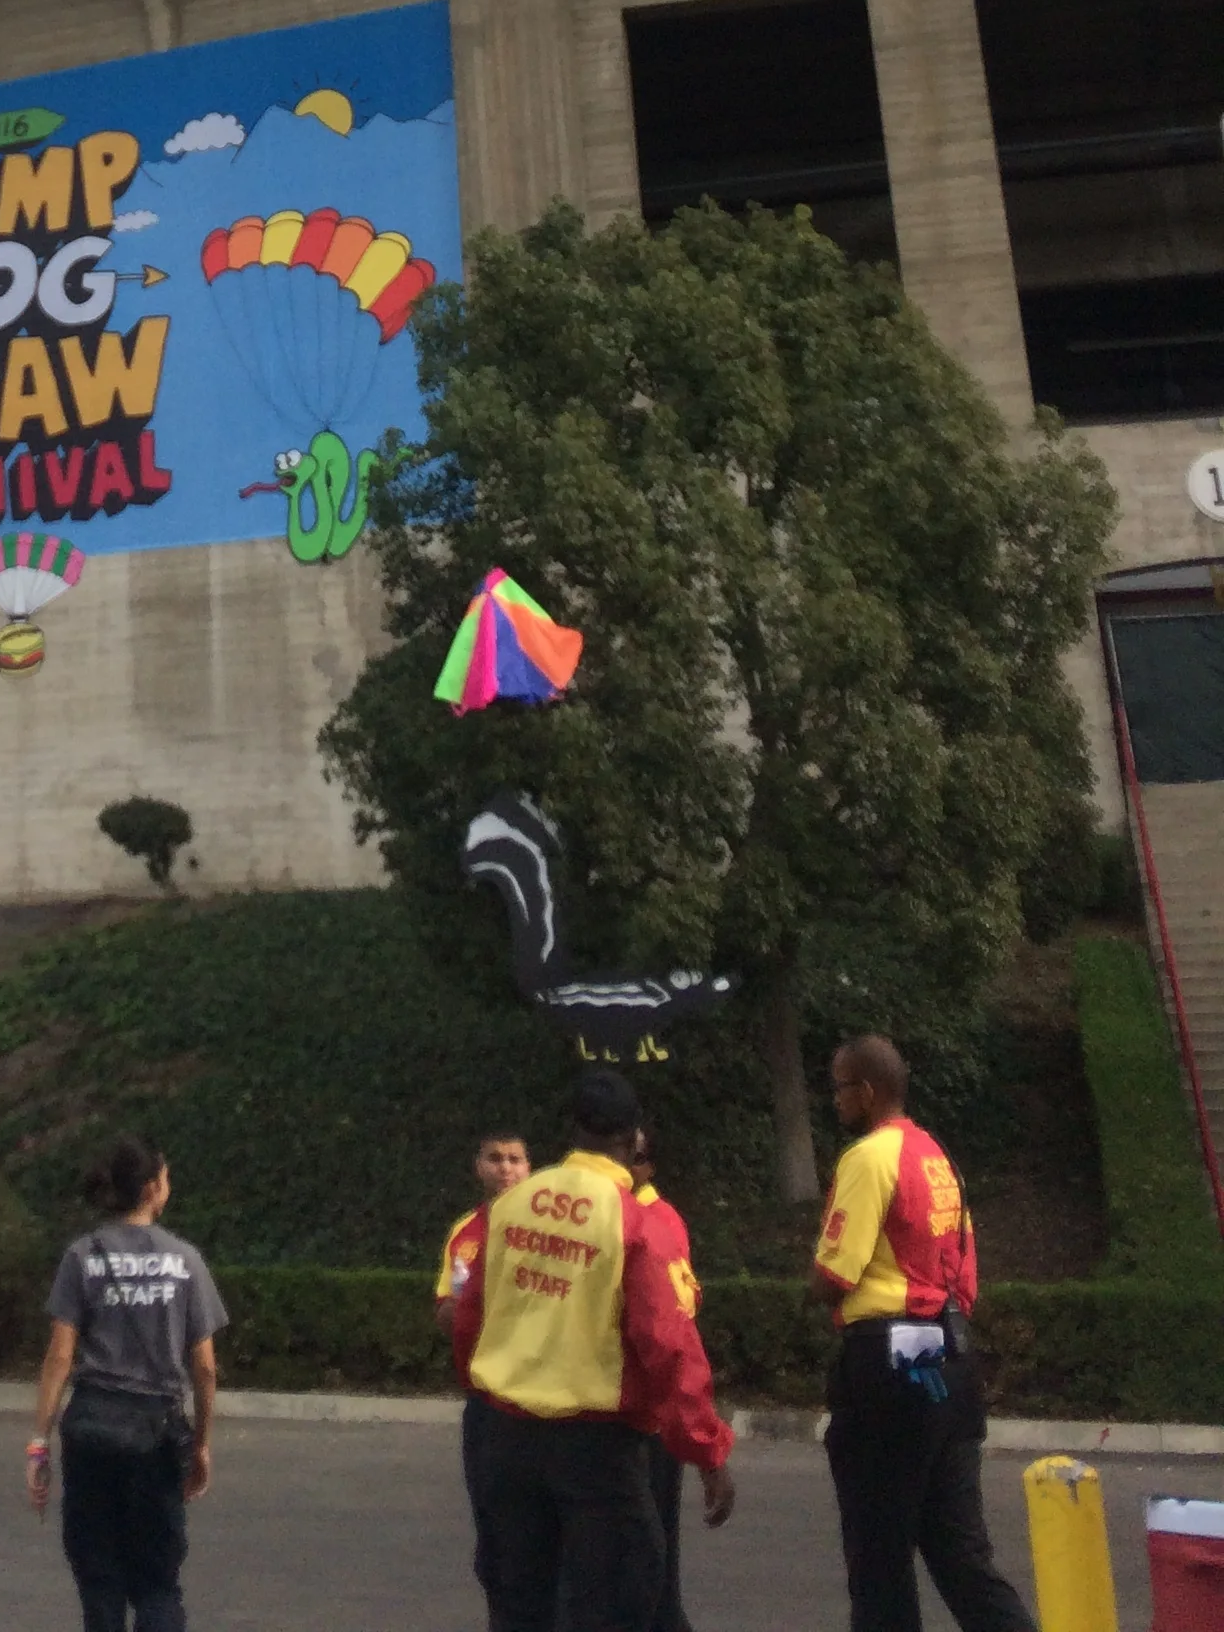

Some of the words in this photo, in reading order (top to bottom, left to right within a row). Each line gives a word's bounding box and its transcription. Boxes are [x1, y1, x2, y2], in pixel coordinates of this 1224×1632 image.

[531, 1187, 594, 1225] CSC
[504, 1226, 600, 1268] SECURITY
[85, 1252, 191, 1279] MEDICAL
[104, 1282, 176, 1306] STAFF
[514, 1266, 572, 1300] STAFF
